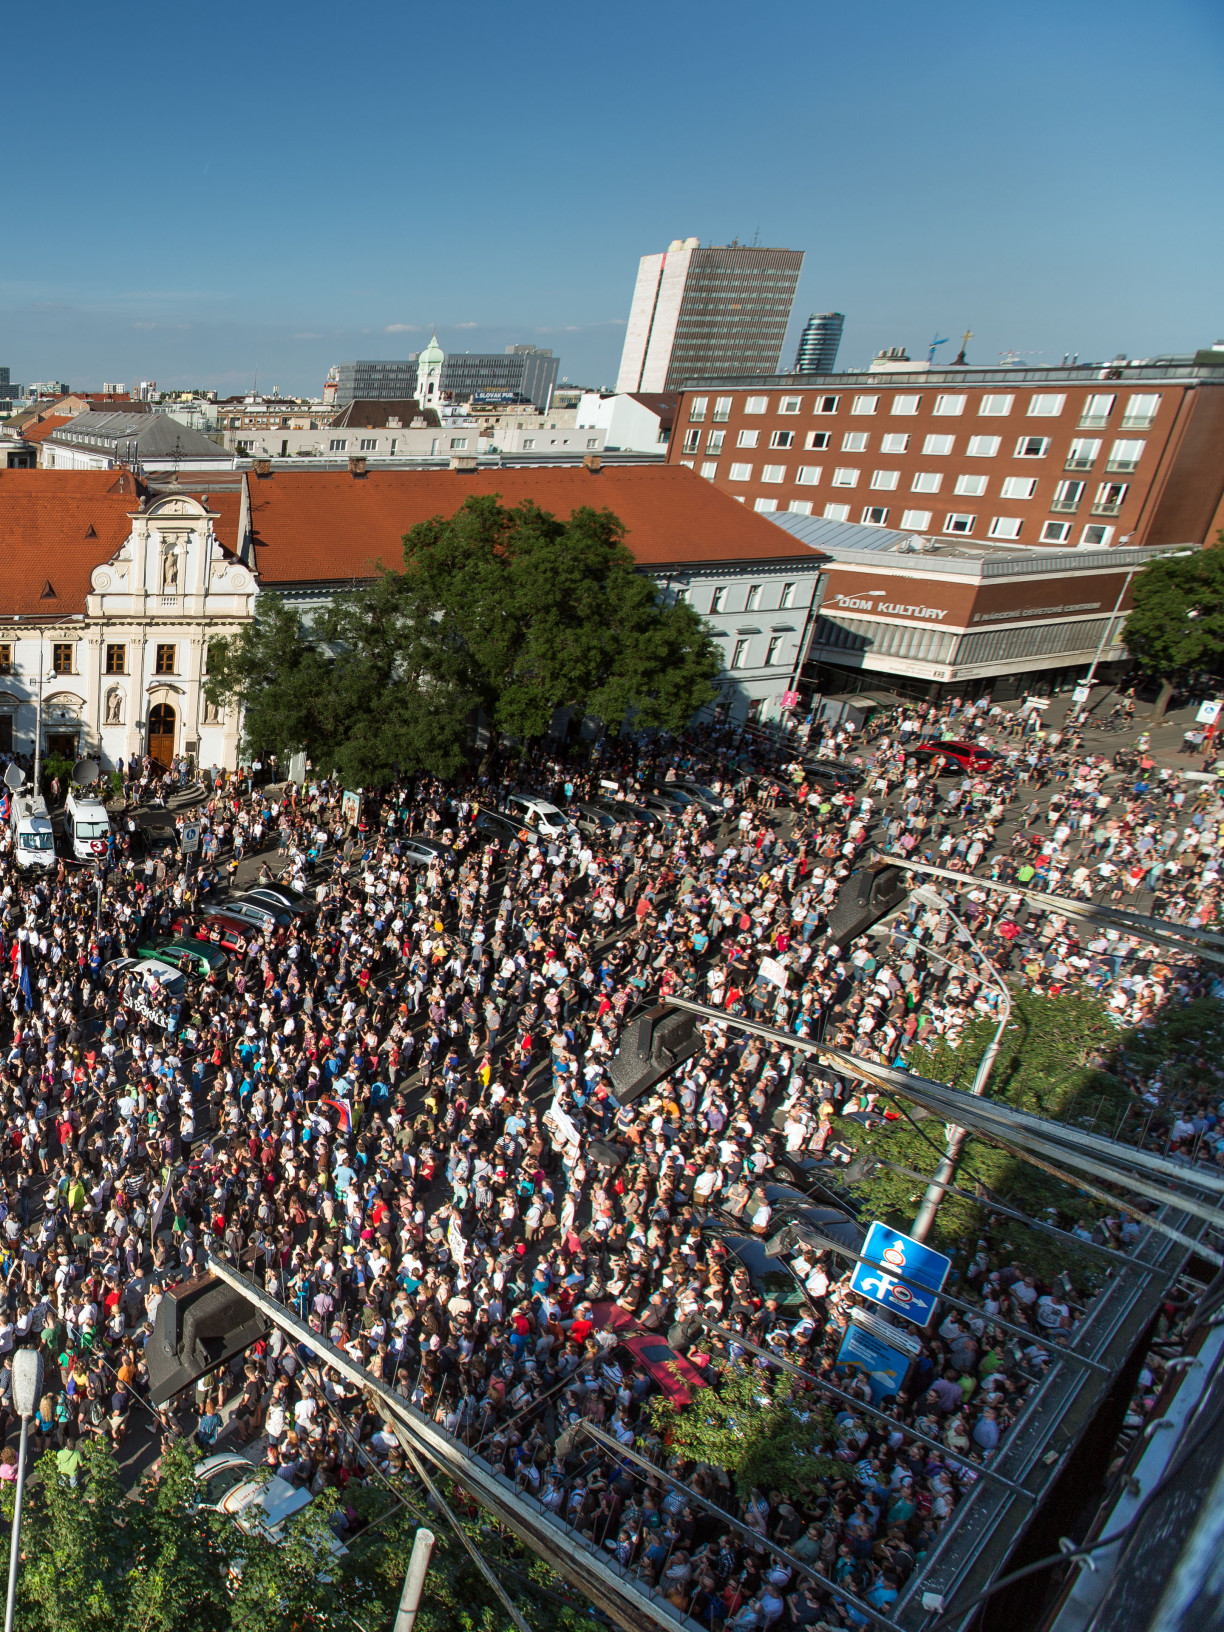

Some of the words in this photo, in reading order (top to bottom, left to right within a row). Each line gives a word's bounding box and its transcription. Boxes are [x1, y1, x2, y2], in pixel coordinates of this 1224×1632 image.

[838, 598, 873, 610] DOM
[877, 602, 948, 620] KULTÚRY
[92, 841, 102, 851] 3
